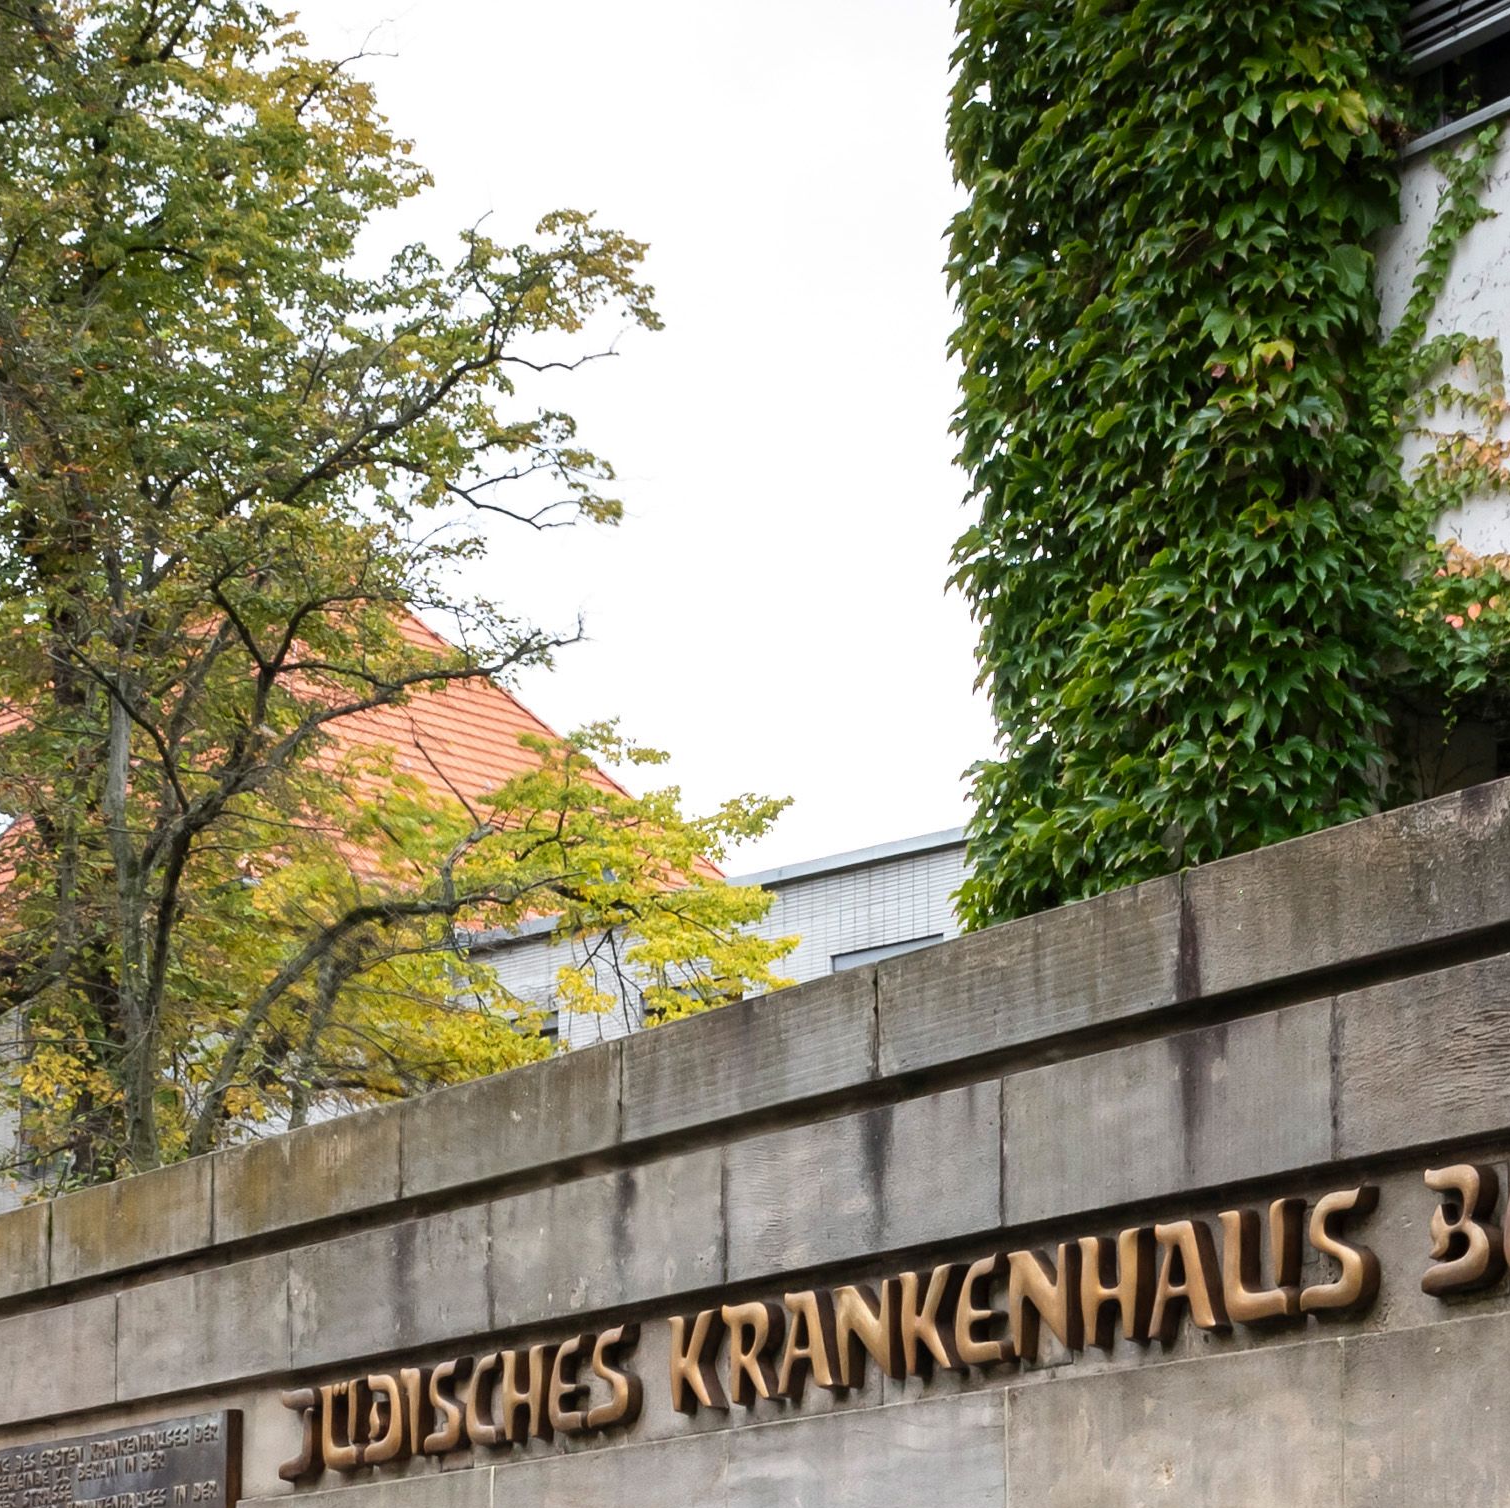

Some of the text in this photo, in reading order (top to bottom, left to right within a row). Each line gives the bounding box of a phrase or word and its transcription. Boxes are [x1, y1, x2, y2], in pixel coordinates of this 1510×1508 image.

[278, 1323, 644, 1482] JÜDISCHES
[669, 1184, 1381, 1415] KRANKENHAUS
[15, 1451, 36, 1472] DES
[40, 1443, 83, 1468] ERSTEN
[89, 1425, 189, 1460] KRANKENHAUSES
[194, 1419, 219, 1442] DER
[77, 1456, 117, 1481] BERLIN
[124, 1453, 136, 1474] IN
[140, 1448, 165, 1471] DER
[24, 1482, 71, 1507] STRASSE
[174, 1483, 188, 1504] IN
[192, 1478, 218, 1502] DER
